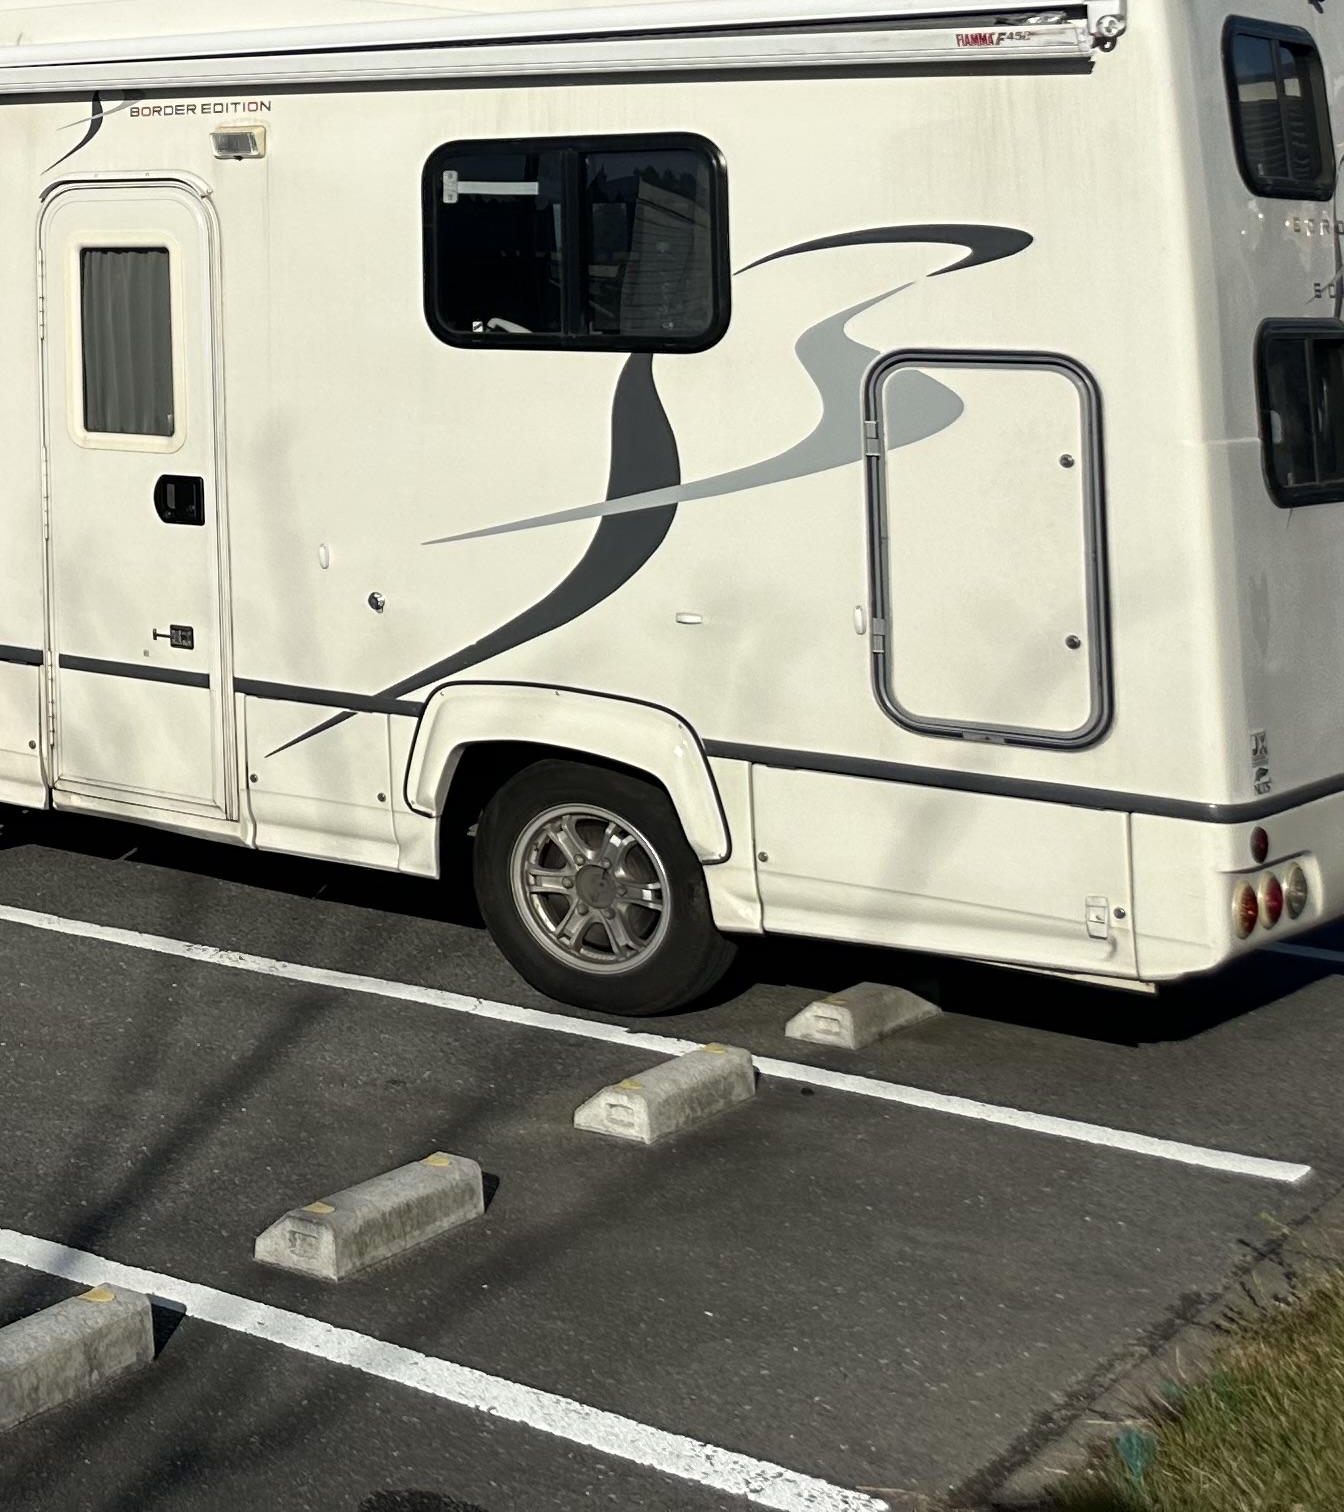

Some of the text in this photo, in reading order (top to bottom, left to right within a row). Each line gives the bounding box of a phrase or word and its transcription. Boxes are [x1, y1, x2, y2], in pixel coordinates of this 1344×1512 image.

[955, 32, 994, 47] FIAMMA
[130, 100, 272, 118] BORDER EDITION
